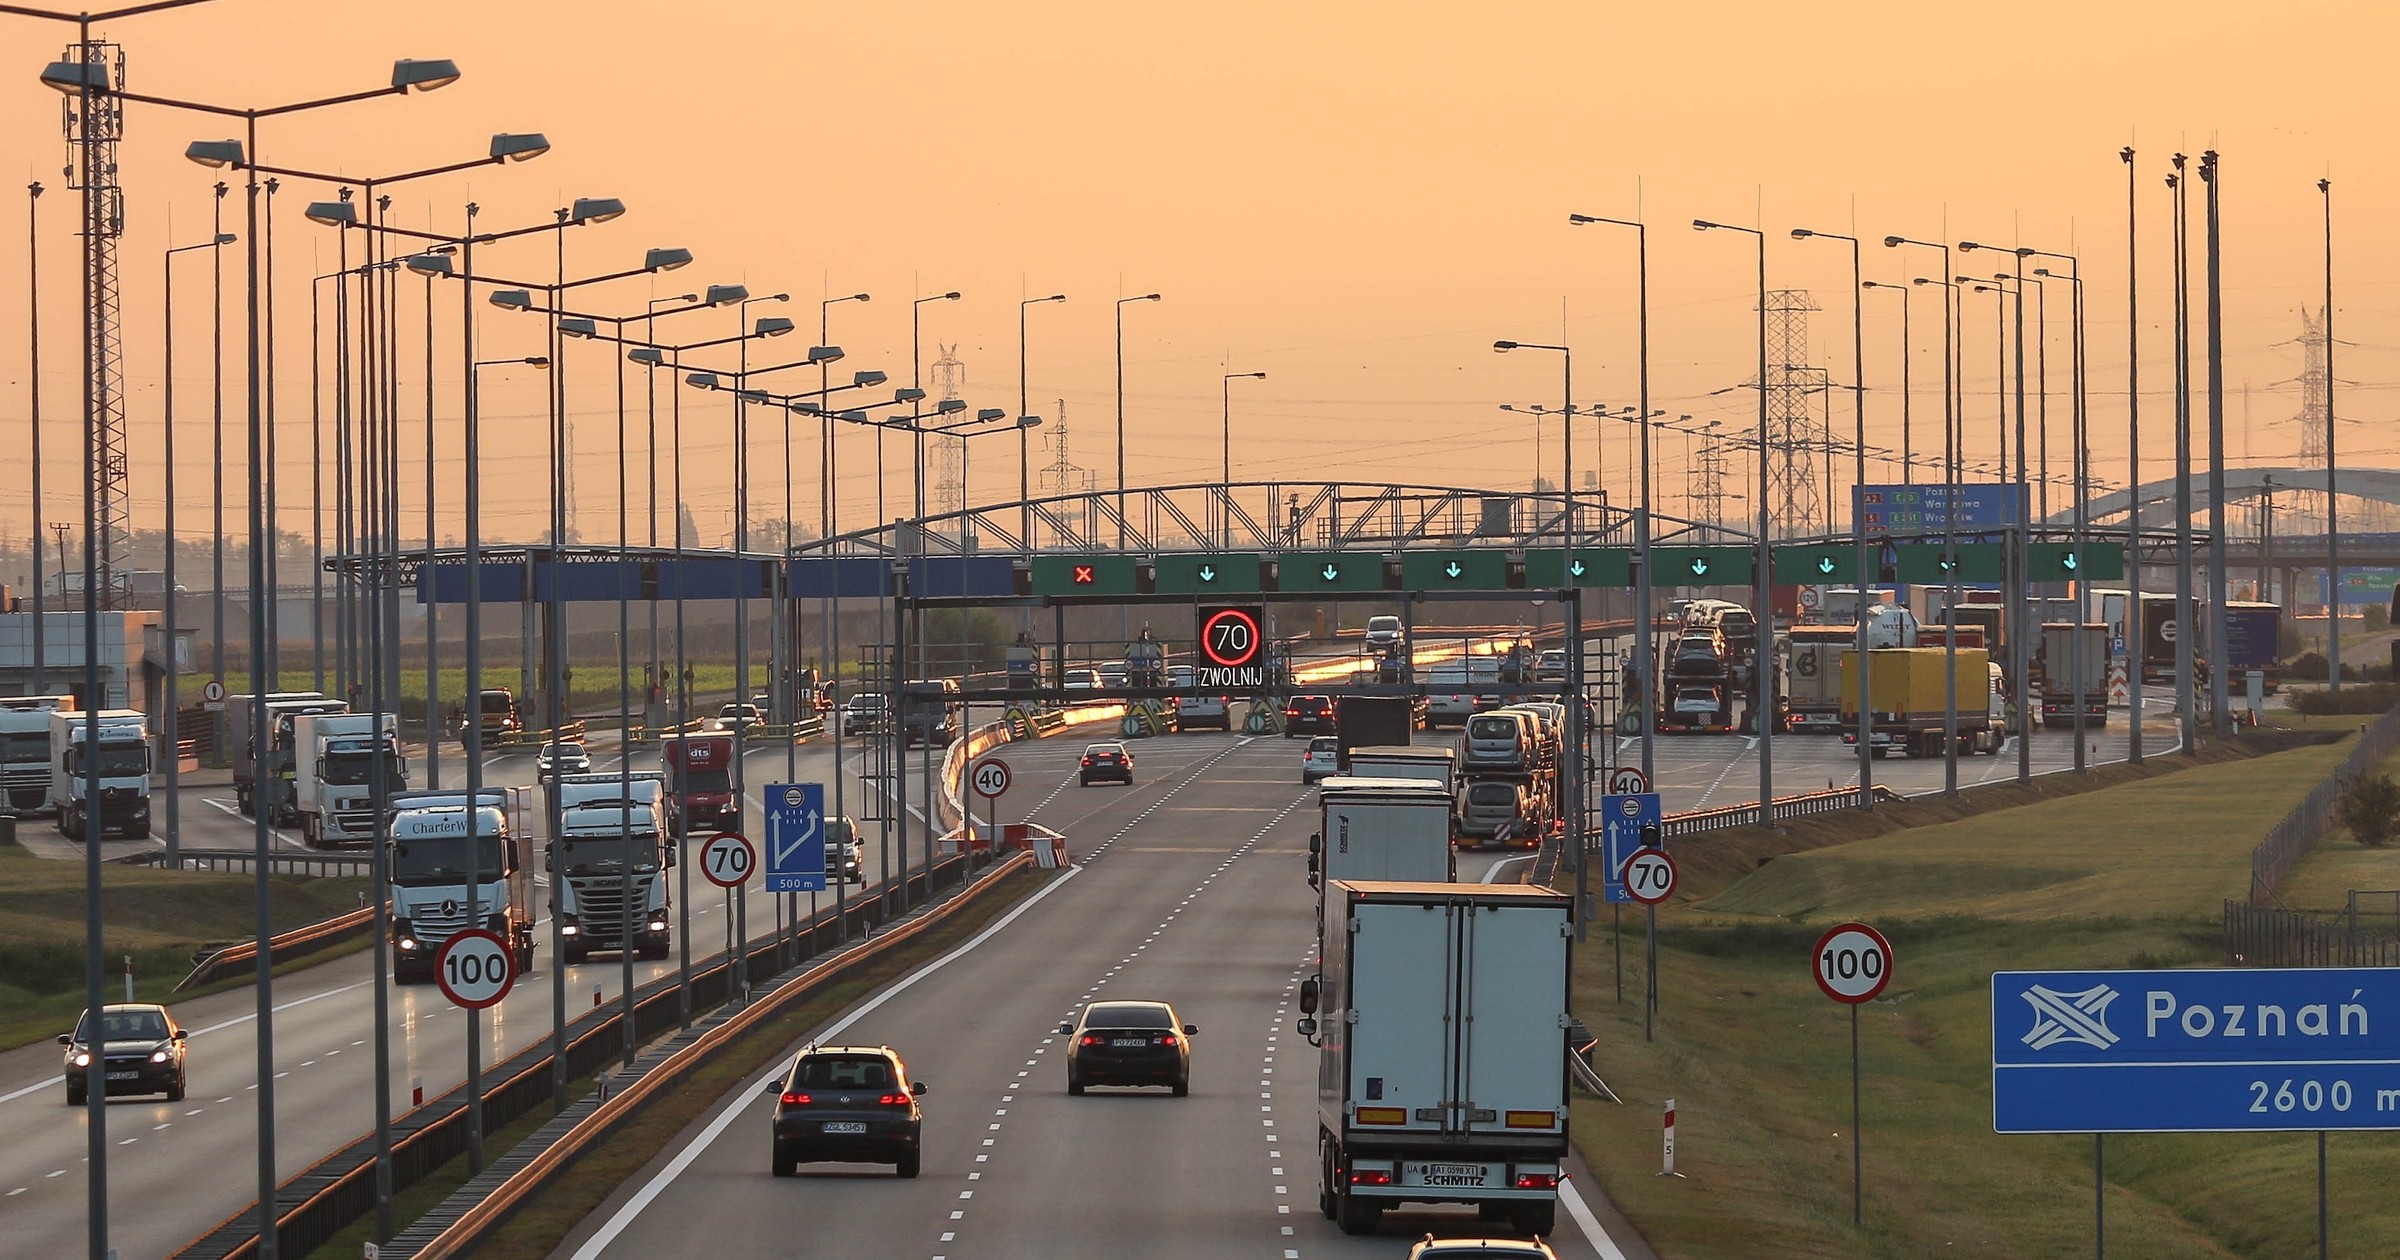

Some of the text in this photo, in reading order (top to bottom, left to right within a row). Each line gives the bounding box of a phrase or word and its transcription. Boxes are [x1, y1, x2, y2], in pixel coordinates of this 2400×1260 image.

[1215, 624, 1248, 651] 70
[1200, 666, 1263, 687] ZWOLNIJ
[690, 749, 709, 758] dts
[979, 770, 1005, 788] 40
[1617, 777, 1642, 794] 40
[712, 846, 748, 873] 70
[780, 879, 800, 889] 500
[1635, 863, 1670, 890] 70
[446, 953, 506, 985] 100
[1822, 948, 1882, 980] 100
[2147, 988, 2368, 1038] Poznań
[2249, 1079, 2352, 1113] 2600
[1665, 1145, 1672, 1155] 5
[1407, 1165, 1418, 1174] UA
[1424, 1175, 1485, 1187] SCHMITZ
